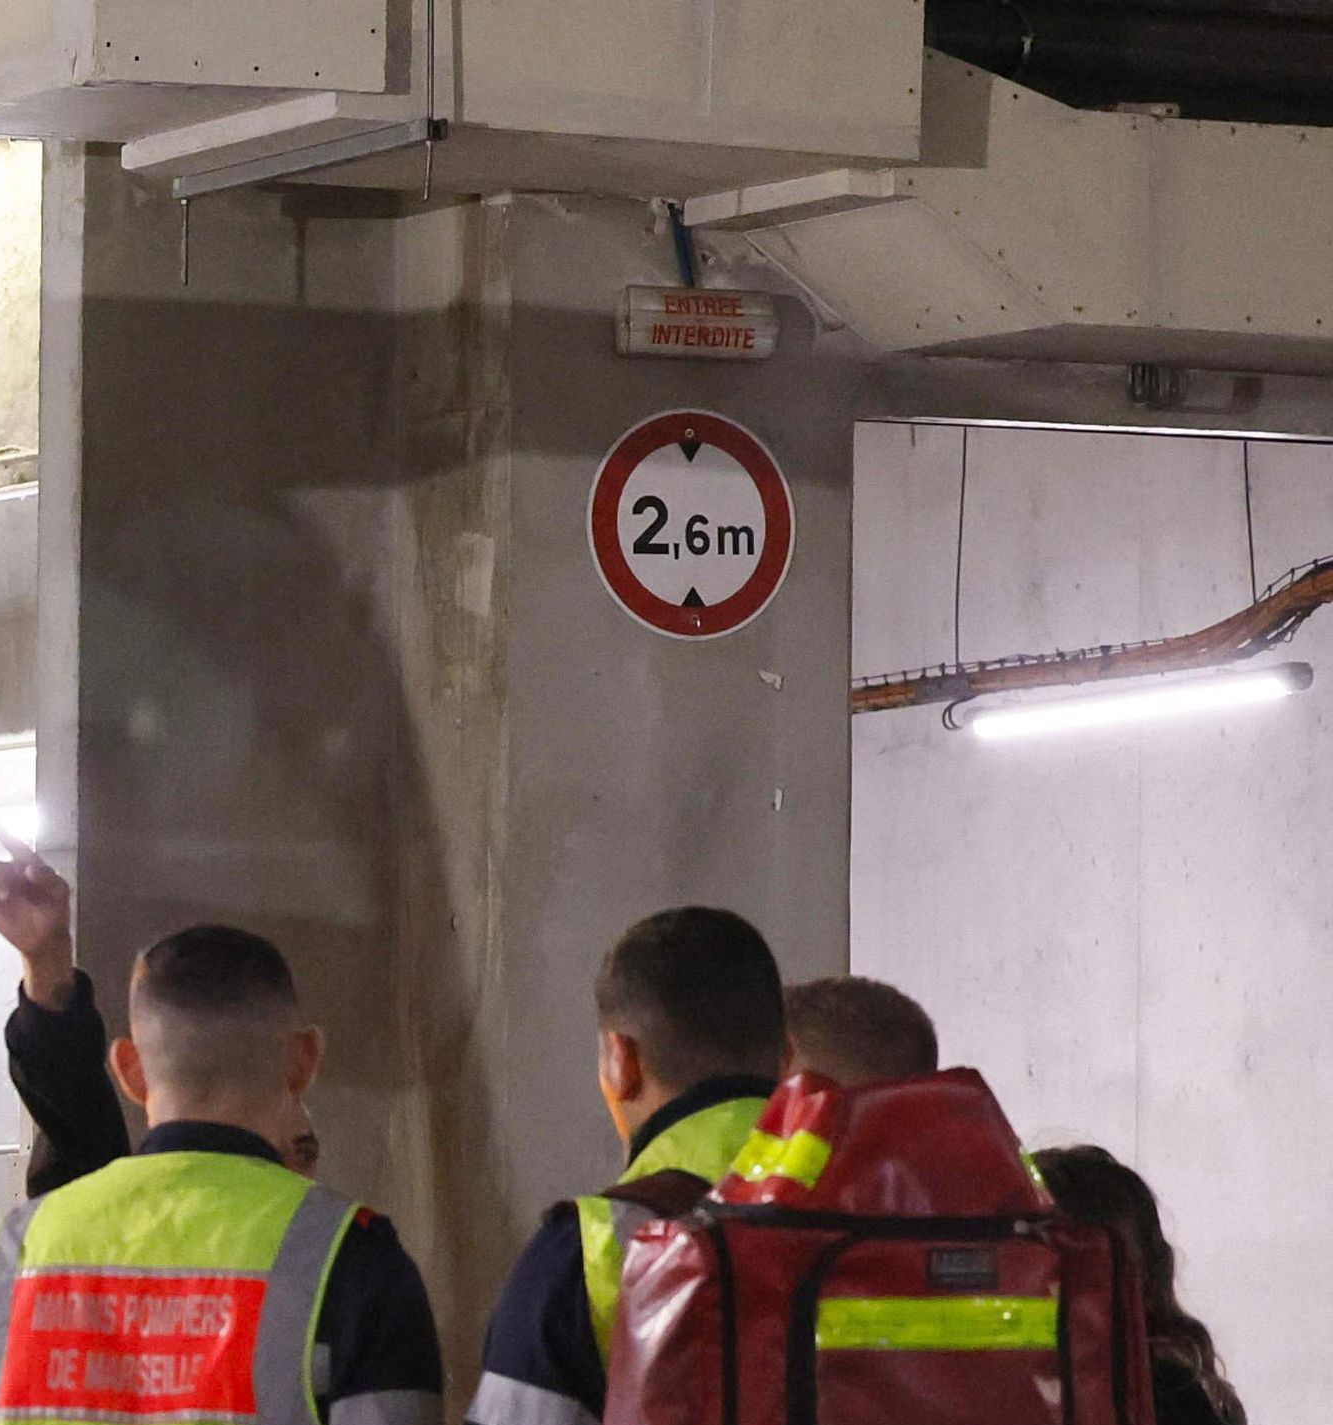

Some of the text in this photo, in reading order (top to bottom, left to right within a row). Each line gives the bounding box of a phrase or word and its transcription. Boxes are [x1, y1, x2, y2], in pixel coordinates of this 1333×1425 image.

[651, 324, 755, 348] INTERDITE
[123, 1294, 232, 1338] POMPIERS
[47, 1348, 78, 1390] DE
